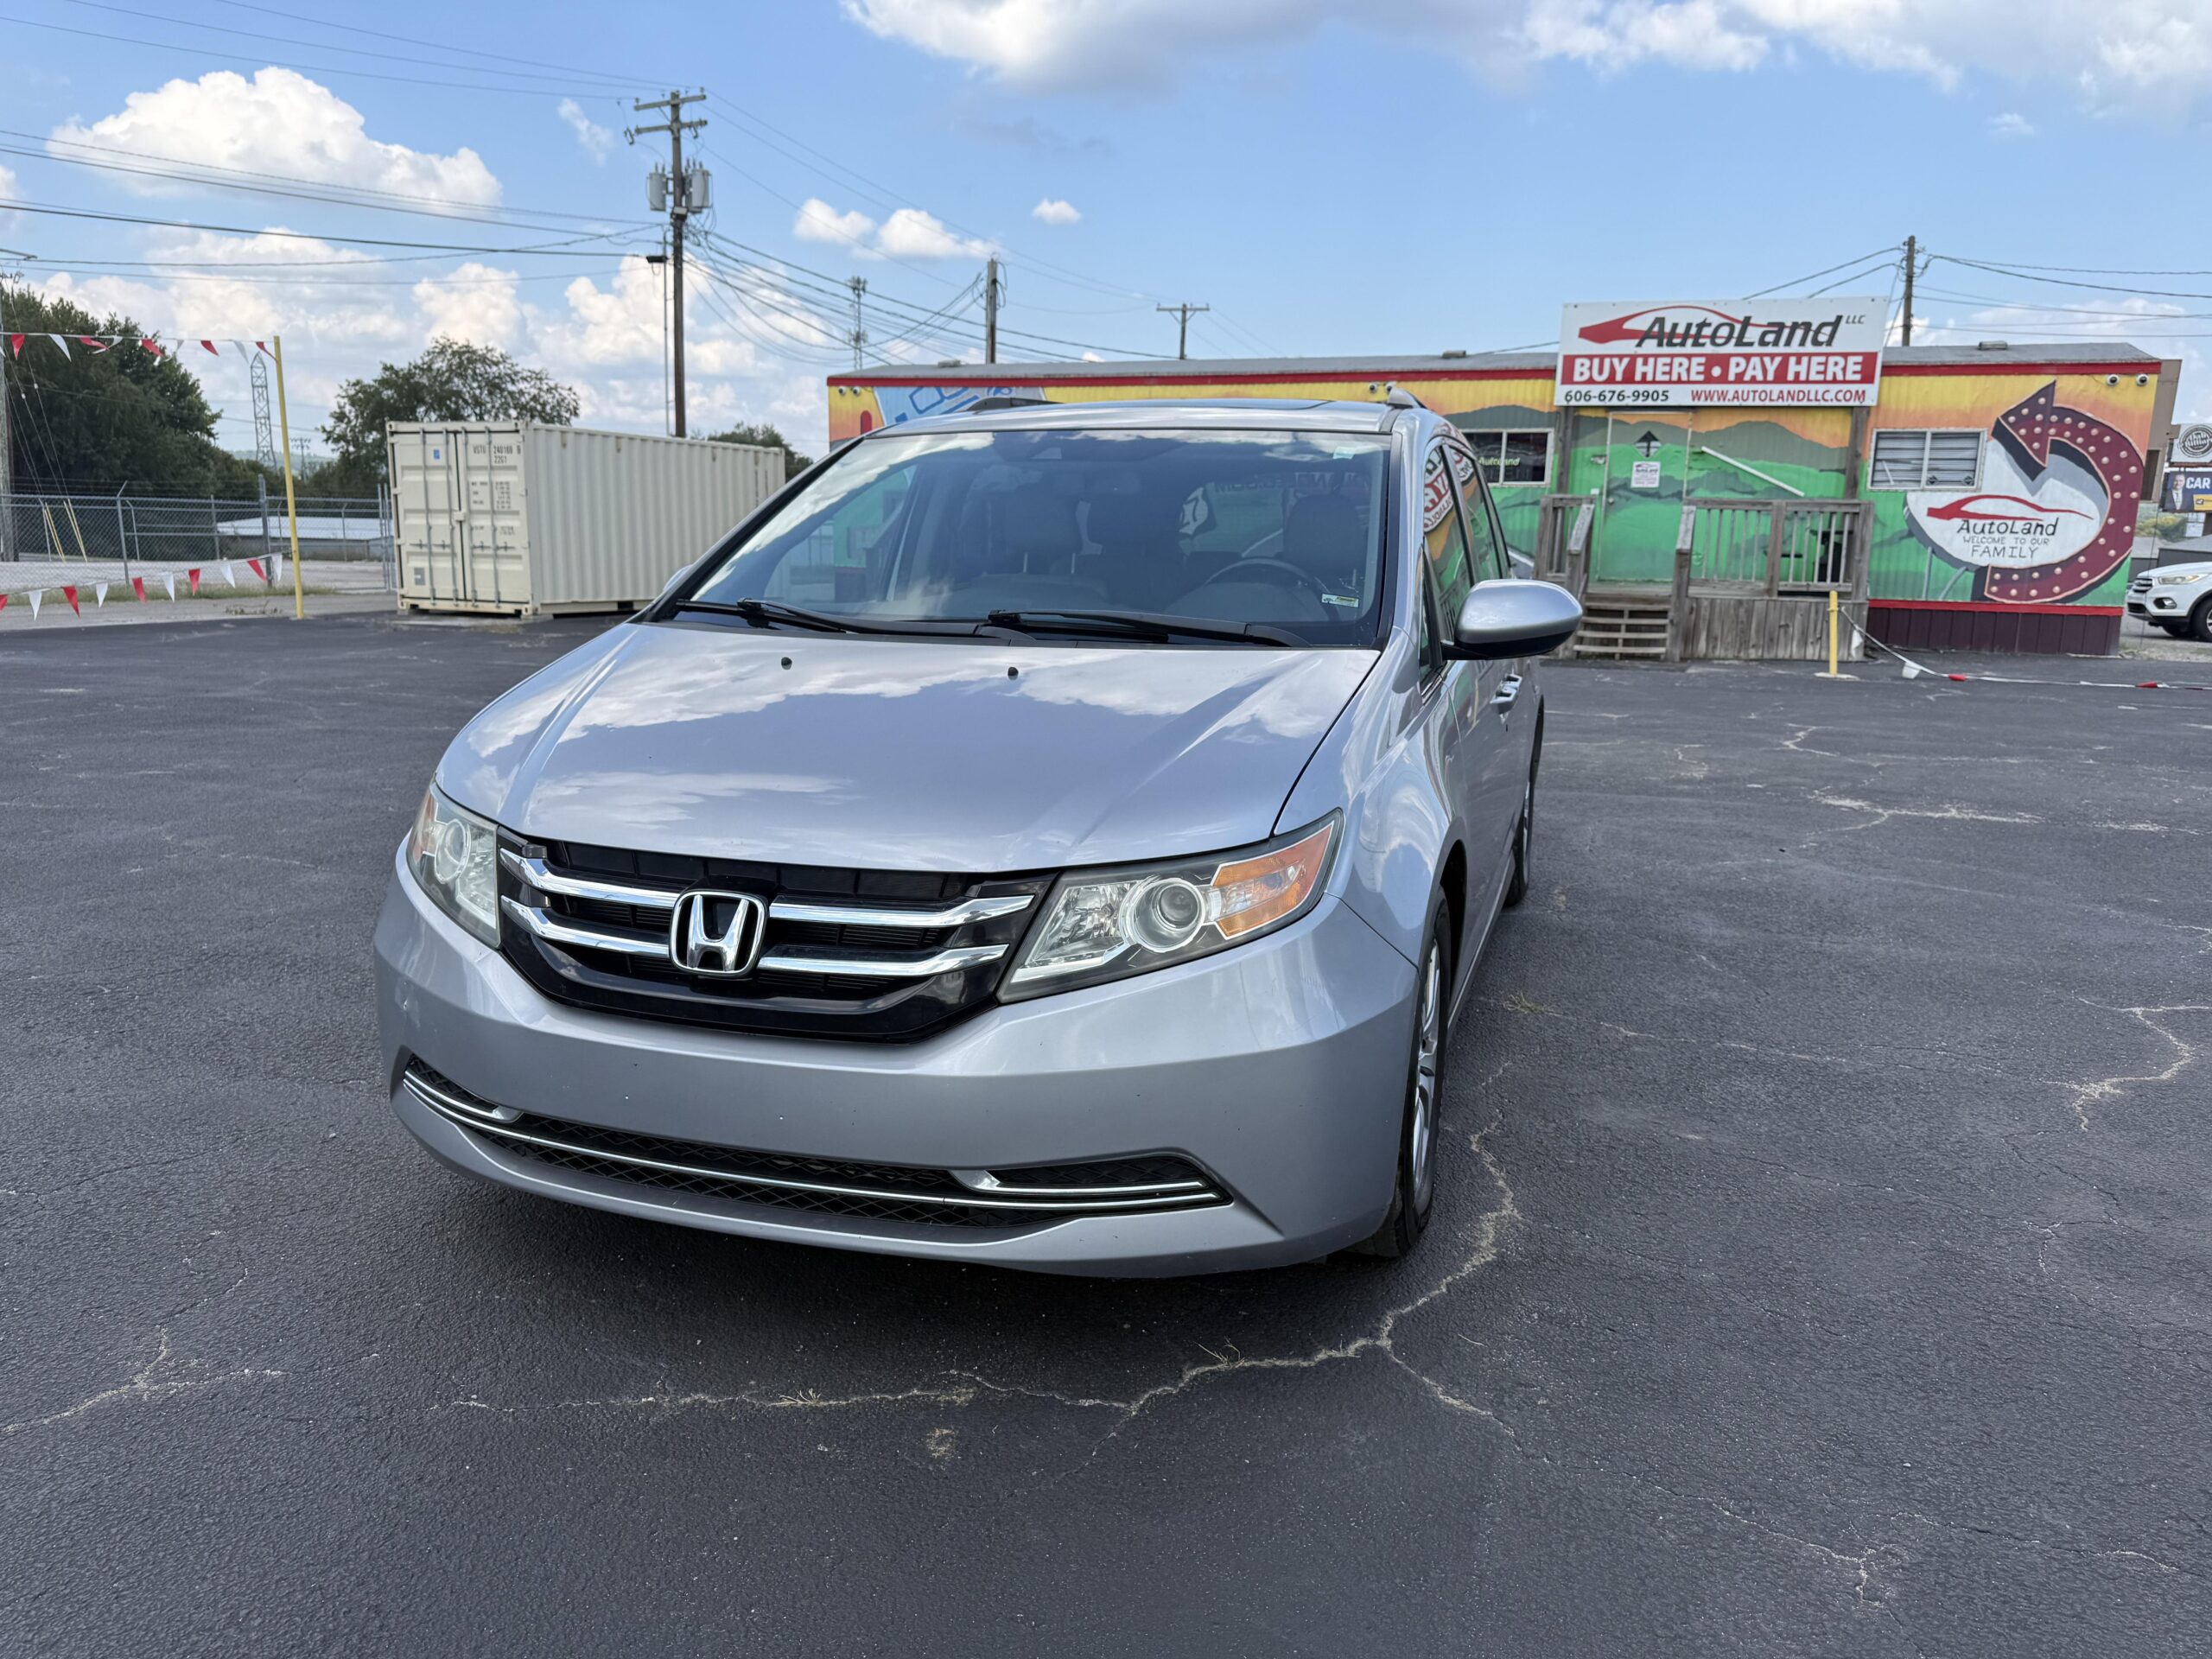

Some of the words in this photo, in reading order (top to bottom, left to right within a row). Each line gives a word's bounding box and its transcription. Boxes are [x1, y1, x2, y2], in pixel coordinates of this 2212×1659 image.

[1636, 315, 1843, 347] AutoLand
[1846, 315, 1866, 325] LLC
[1573, 357, 1630, 383] BUY
[1634, 356, 1706, 382] HERE
[1727, 356, 1784, 381] PAY
[1787, 355, 1863, 381] HERE
[1564, 390, 1669, 404] 606-676-9905
[1691, 389, 1866, 404] WWW.AUTOLANDLLC.COM
[2185, 477, 2211, 490] CAR
[1957, 517, 2060, 537] AutoLand
[1963, 536, 2006, 546] WELCOME
[2014, 537, 2027, 545] TO
[2030, 537, 2051, 546] OUR
[1971, 545, 2039, 559] FAMILY
